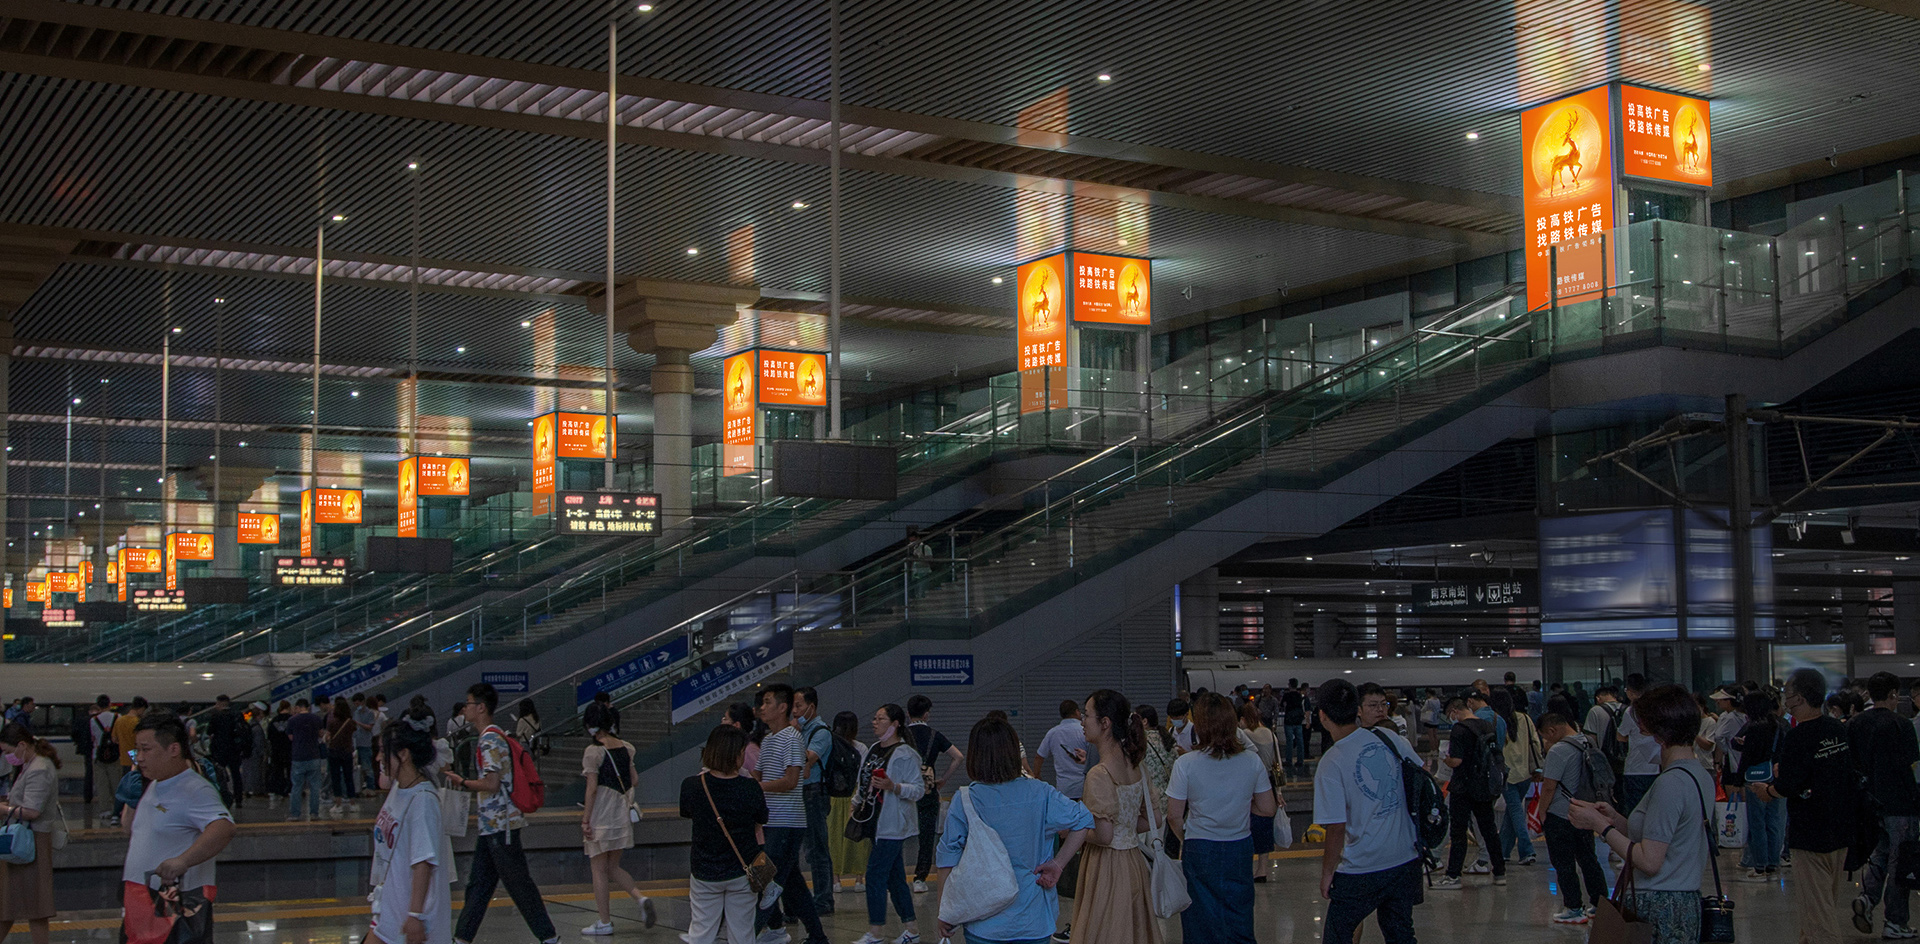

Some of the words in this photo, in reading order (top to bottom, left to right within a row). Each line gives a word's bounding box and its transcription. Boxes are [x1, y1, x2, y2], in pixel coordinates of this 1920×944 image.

[1628, 102, 1670, 122] 投高铁广告
[1628, 118, 1670, 138] 找路铁传媒
[1536, 203, 1602, 232] 投高铁广告
[1537, 220, 1602, 248] 找路铁传媒
[1079, 266, 1115, 279] 投高铁广告
[1079, 278, 1116, 290] 找路铁传媒
[1024, 340, 1061, 356] 投高铁广告
[1024, 353, 1061, 368] 找路铁传媒
[1431, 585, 1466, 599] 南京南站
[1502, 582, 1522, 595] 出站
[595, 661, 636, 686] 中转换乘
[690, 658, 735, 689] 中转换乘
